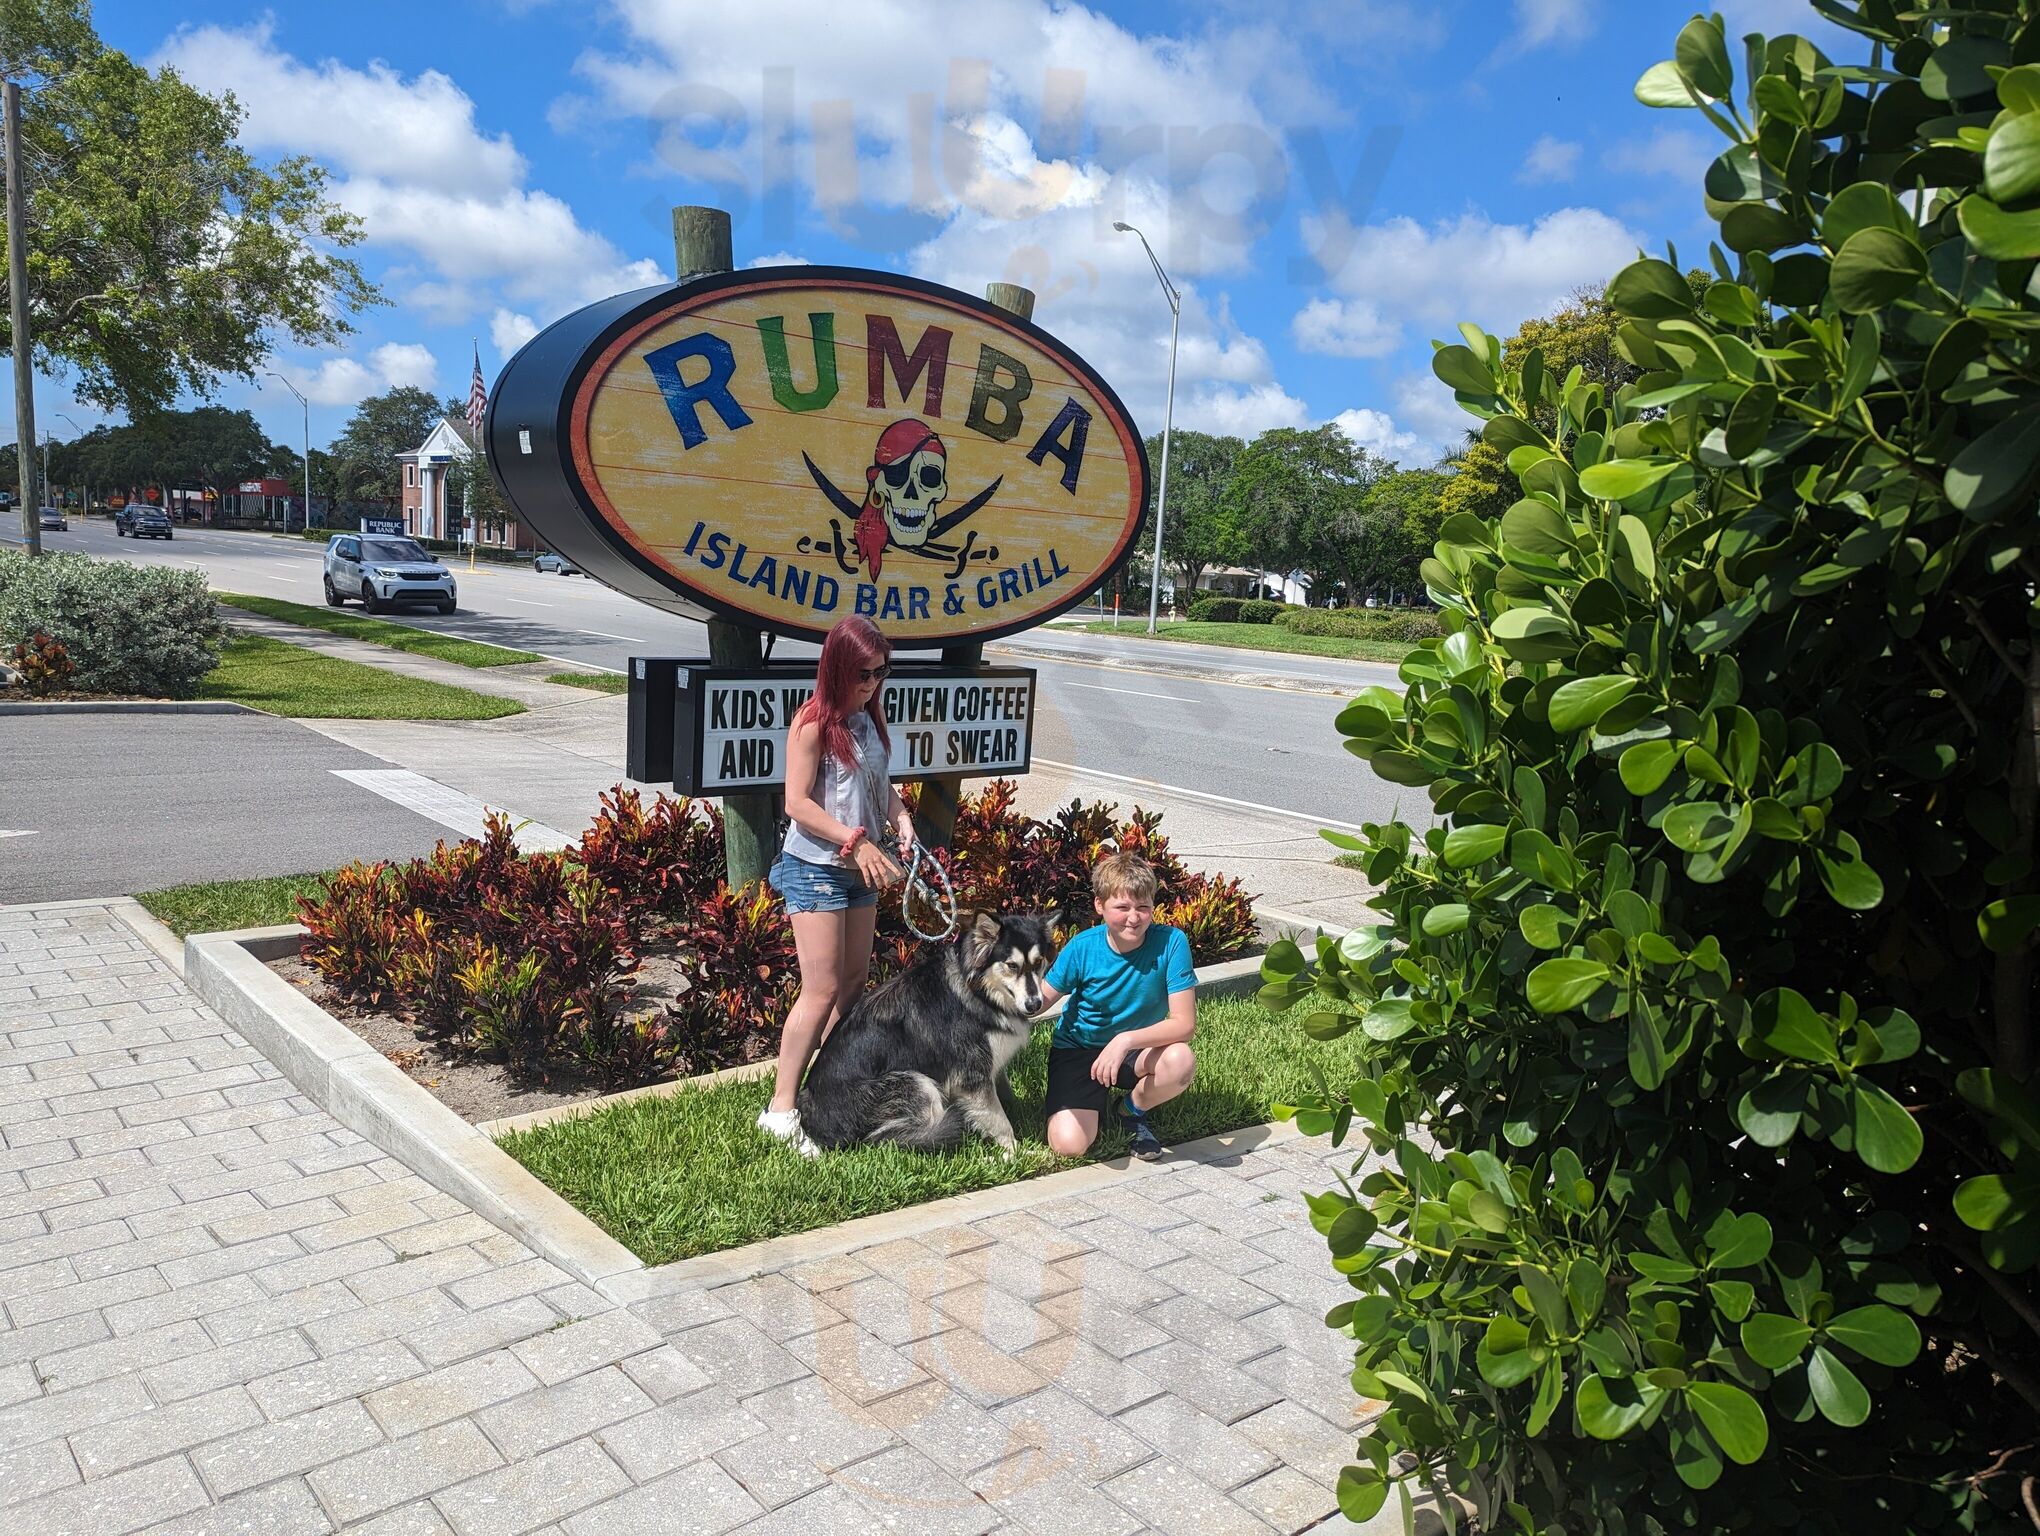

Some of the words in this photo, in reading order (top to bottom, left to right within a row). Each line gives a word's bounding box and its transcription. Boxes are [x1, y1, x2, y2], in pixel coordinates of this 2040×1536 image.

[643, 312, 1093, 497] RUMBA
[368, 520, 402, 529] REPUBLIC
[682, 521, 839, 613] ISLAND
[854, 582, 928, 620] BAR
[943, 583, 966, 615] &
[977, 549, 1070, 610] GRILL
[710, 688, 775, 730] KIDS
[884, 686, 949, 724] GIVEN
[953, 686, 1028, 722] COFFEE
[719, 738, 774, 780] AND
[906, 731, 934, 768] TO
[946, 728, 1018, 766] SWEAR
